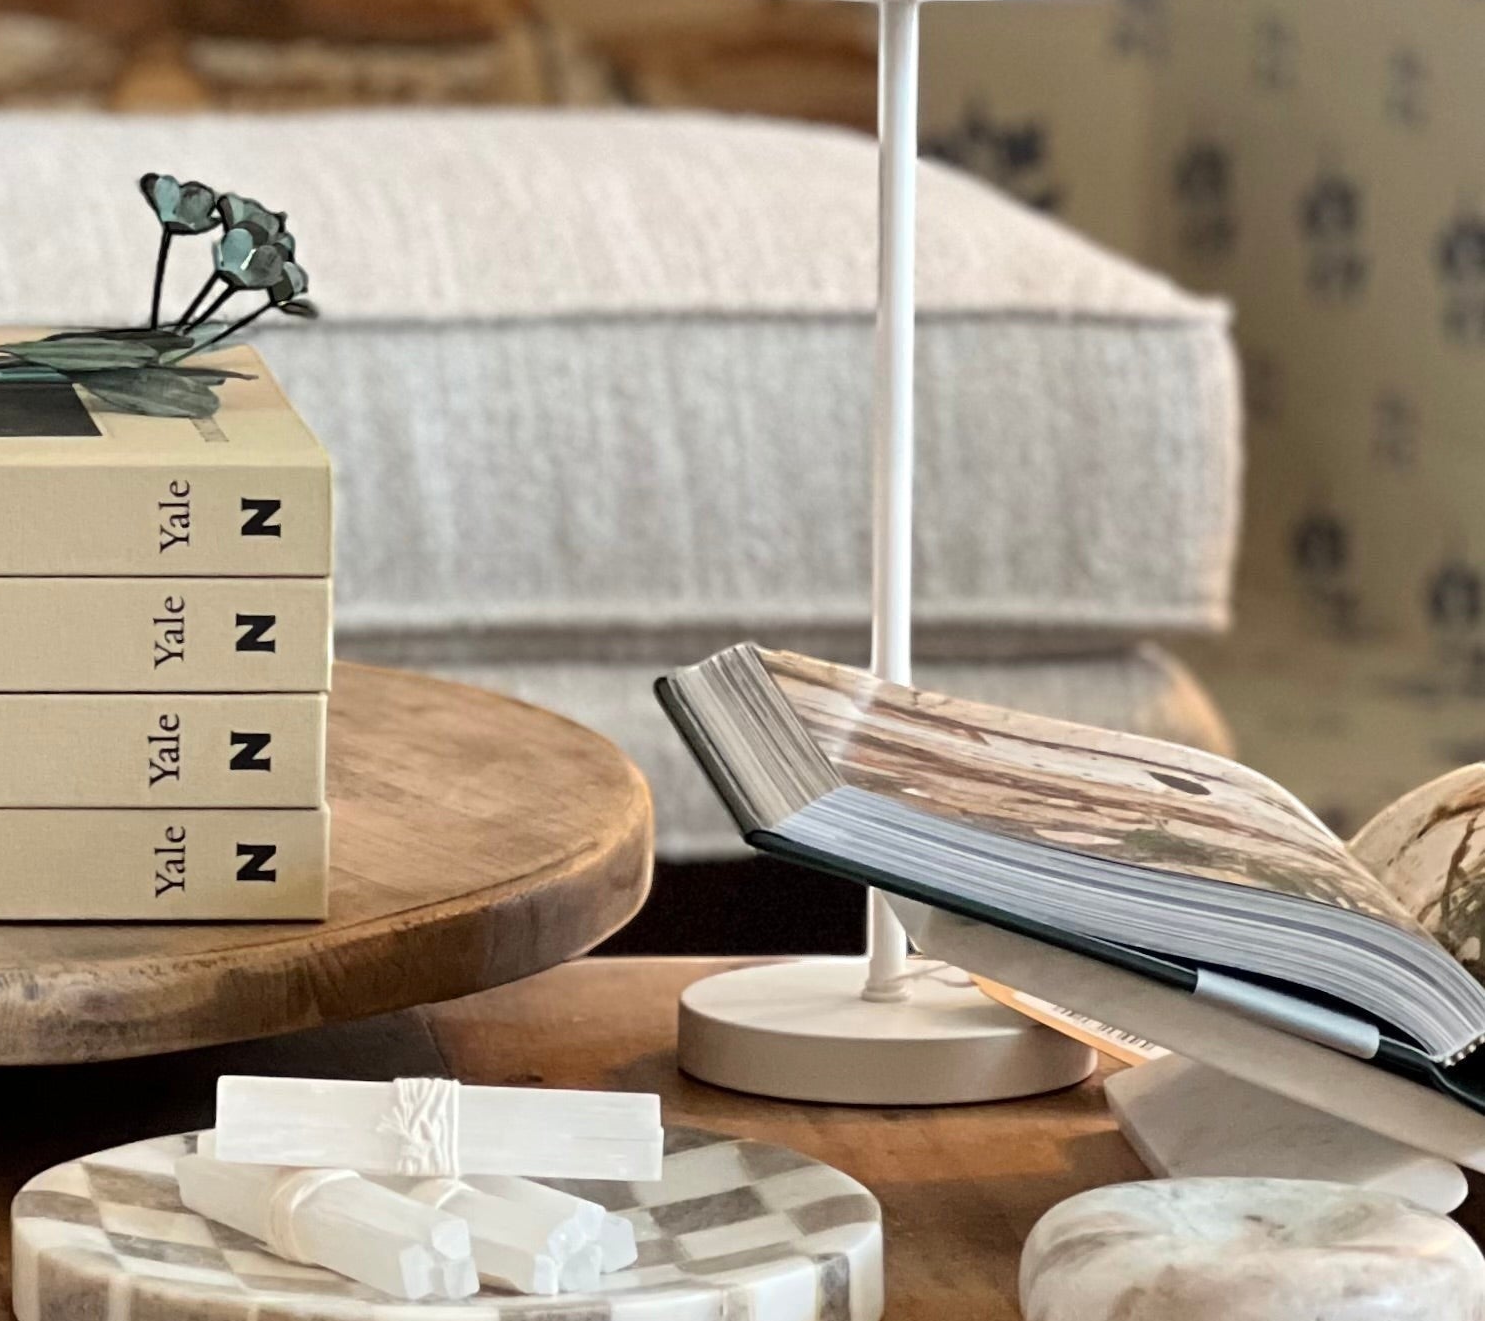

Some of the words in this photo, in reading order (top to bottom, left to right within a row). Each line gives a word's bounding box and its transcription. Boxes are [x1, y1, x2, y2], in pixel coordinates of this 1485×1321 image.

[158, 480, 191, 554] Yale
[241, 497, 282, 538] N
[153, 595, 186, 670] Yale
[235, 613, 276, 653] N
[147, 713, 181, 788] Yale
[229, 731, 271, 772] N
[154, 825, 187, 899] Yale
[236, 843, 277, 883] N
